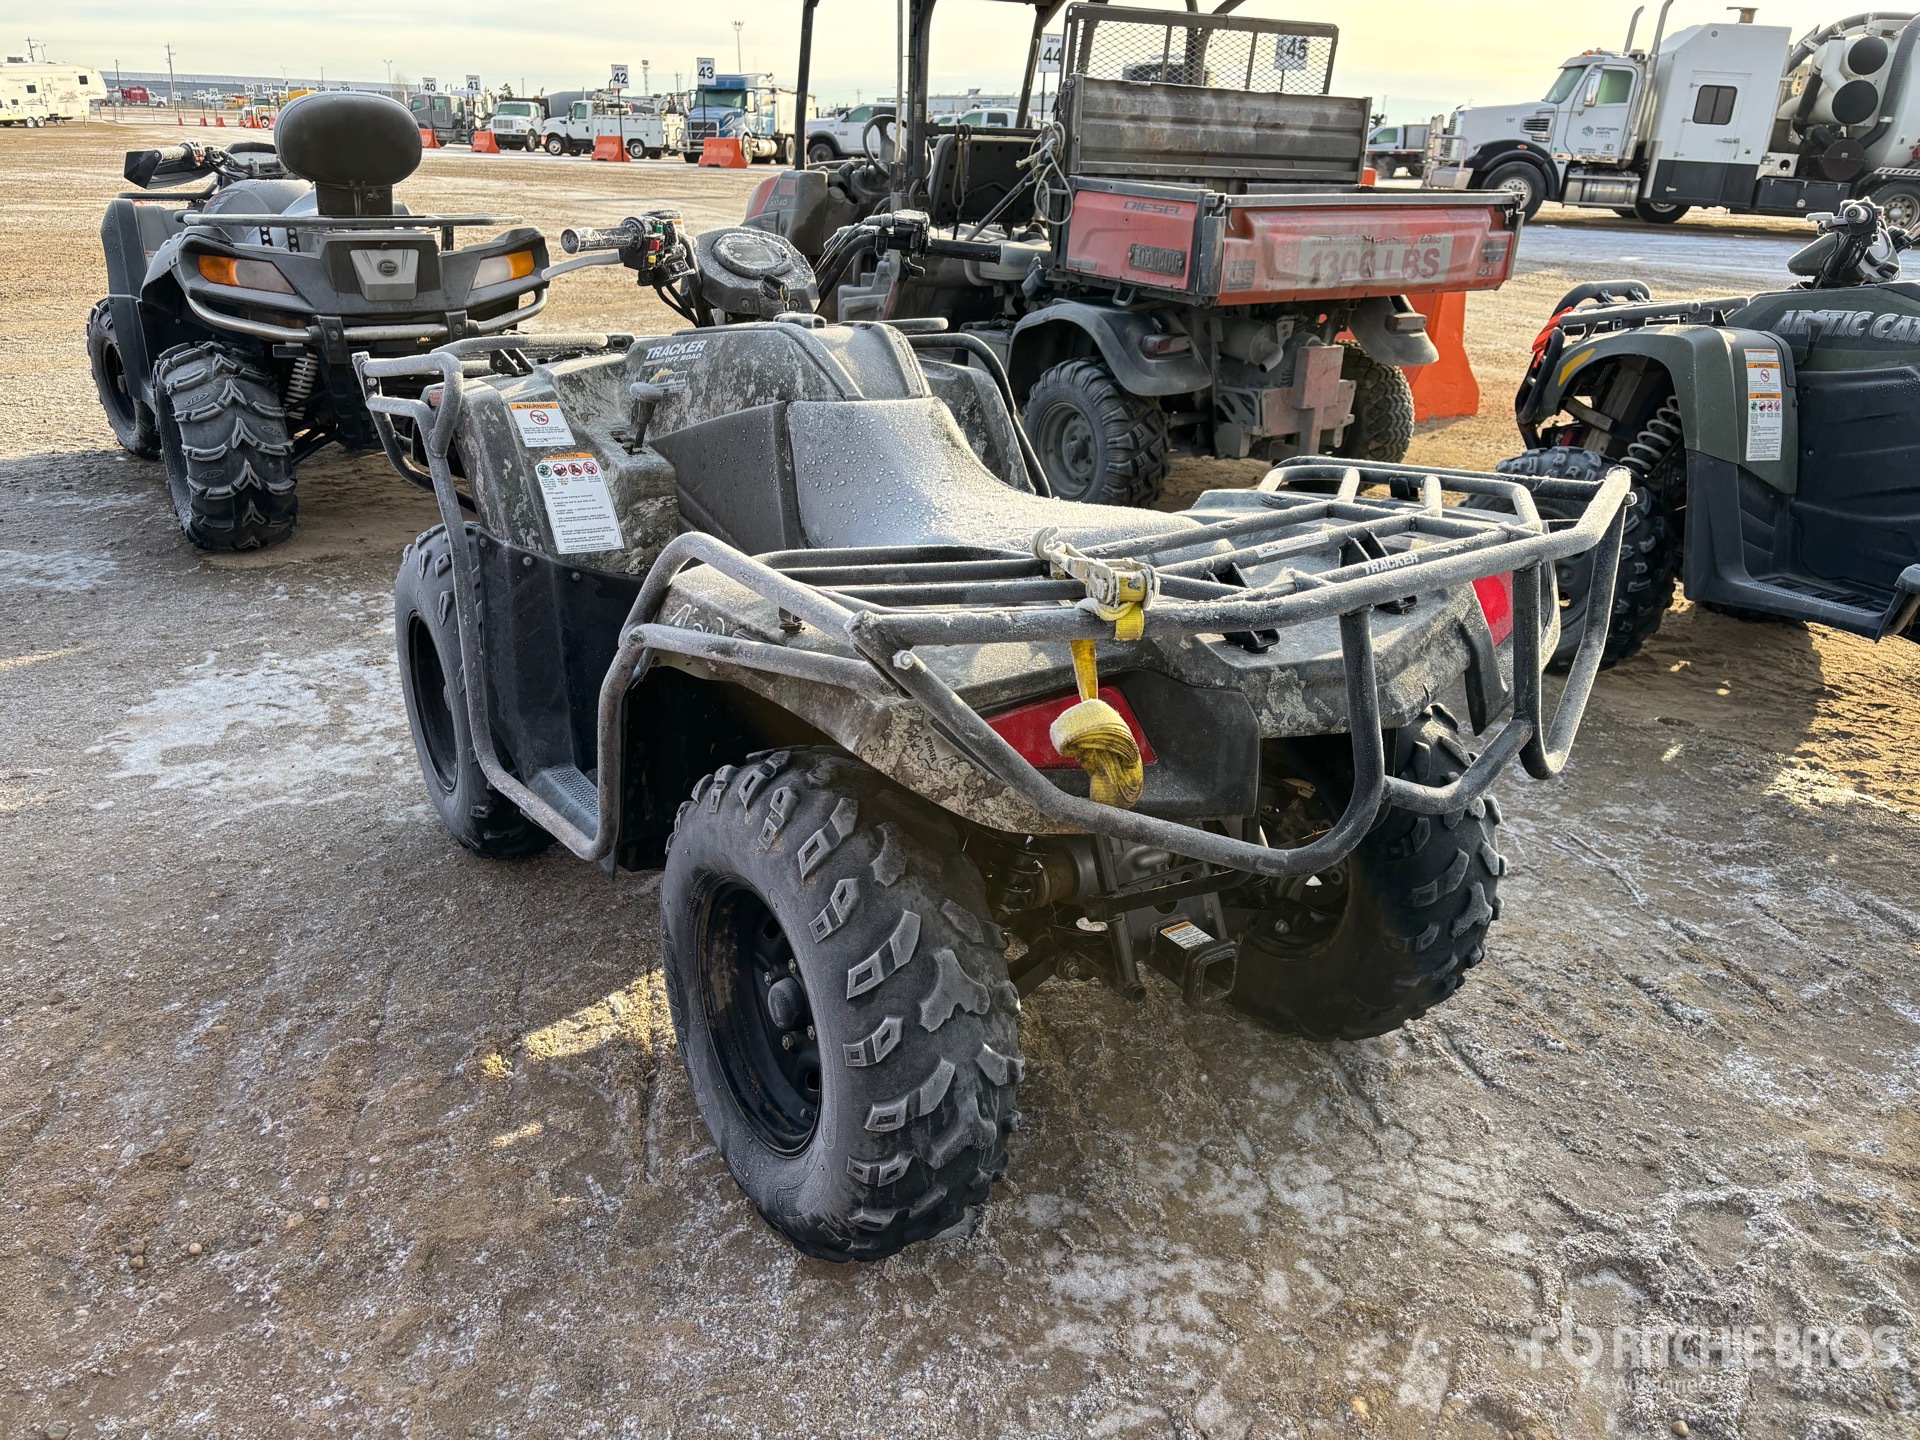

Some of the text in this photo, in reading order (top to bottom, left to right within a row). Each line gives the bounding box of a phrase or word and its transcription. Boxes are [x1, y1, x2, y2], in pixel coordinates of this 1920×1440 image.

[1046, 36, 1060, 44] Lane
[1286, 37, 1307, 60] 45
[1043, 46, 1062, 65] 44
[613, 72, 628, 84] 42
[698, 66, 714, 79] 43
[424, 83, 436, 92] 40
[467, 81, 480, 91] 41
[1123, 200, 1184, 216] DIESEL
[1419, 236, 1441, 244] CARGO
[1384, 247, 1441, 280] LBS
[1869, 312, 1920, 344] CAT
[645, 340, 708, 360] TRACKER
[664, 352, 702, 364] OFF ROAD
[1364, 552, 1420, 575] TRACKER
[1313, 697, 1334, 718] STRATA
[924, 735, 938, 763] STRATA
